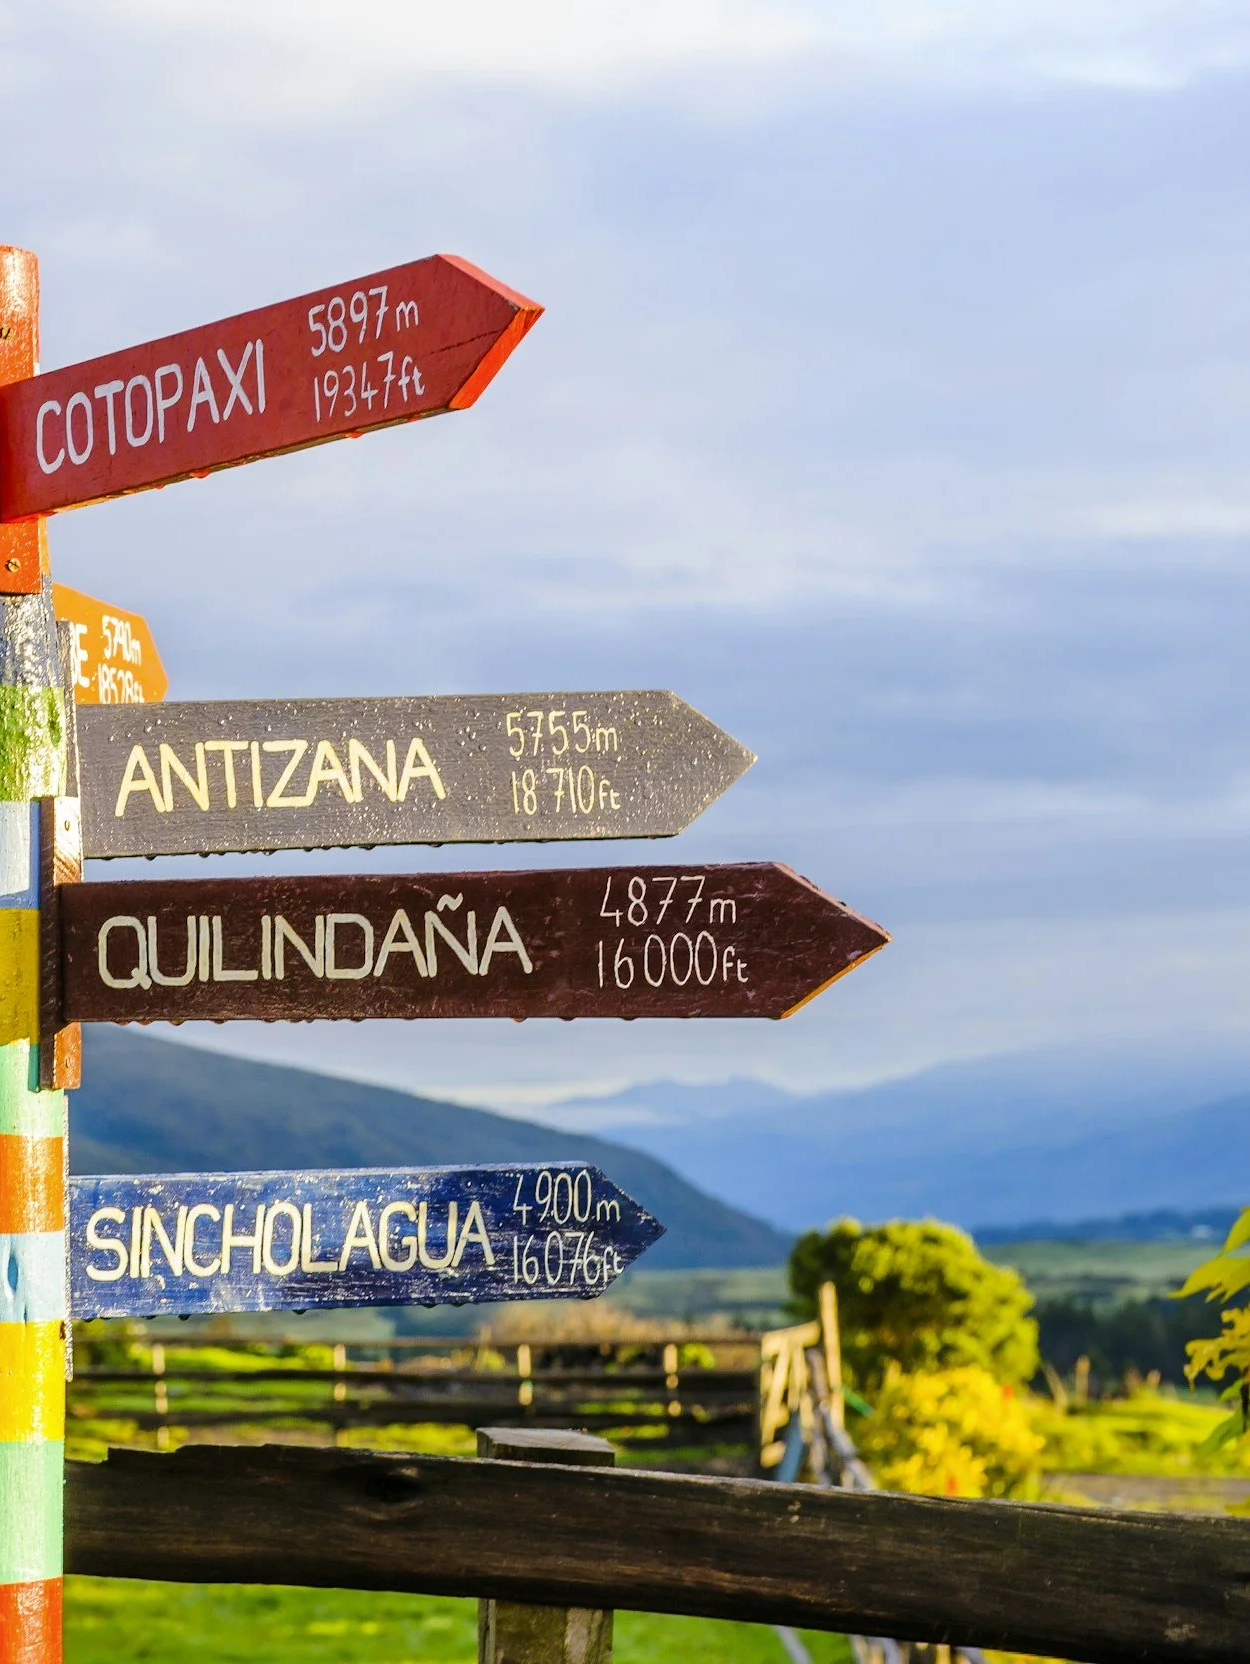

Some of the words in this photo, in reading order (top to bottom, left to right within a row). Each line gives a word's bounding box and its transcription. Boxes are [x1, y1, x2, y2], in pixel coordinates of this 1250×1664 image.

[308, 285, 419, 357] 5897m
[36, 339, 266, 474] COTOPAXI
[313, 350, 426, 423] 19347ft
[506, 710, 619, 757] 5755m
[115, 737, 447, 817] ANTIZANA
[600, 875, 737, 928] 4877m
[98, 893, 533, 990] QUILINDAÑA
[512, 1168, 622, 1226] 4900m
[85, 1200, 496, 1283] SINCHOLAGUA
